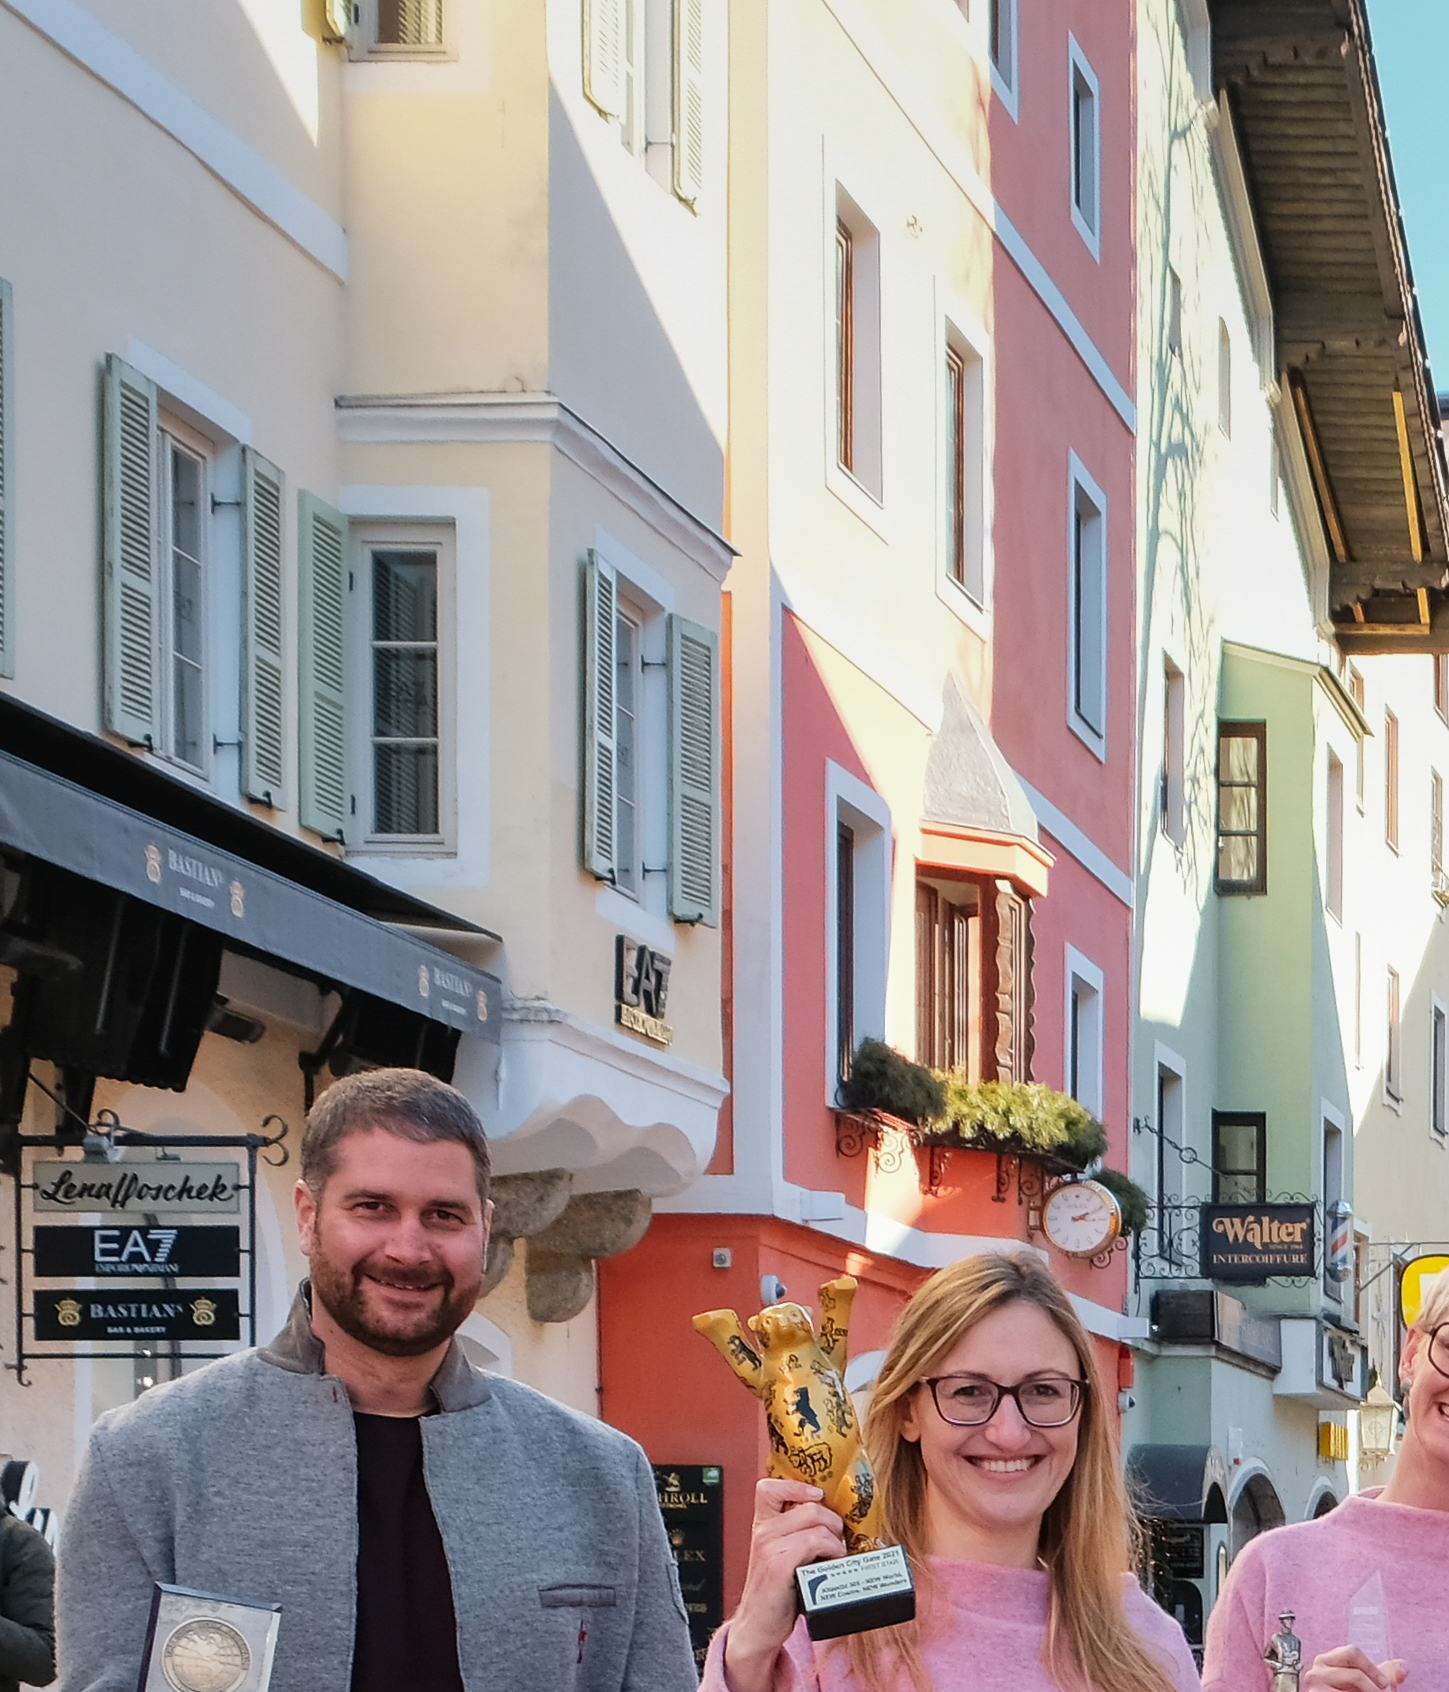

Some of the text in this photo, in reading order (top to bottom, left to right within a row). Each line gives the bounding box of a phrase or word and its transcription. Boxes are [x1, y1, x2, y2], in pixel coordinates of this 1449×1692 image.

[1212, 1215, 1307, 1250] Walter
[94, 1230, 178, 1262] EA7
[1213, 1253, 1308, 1264] INTERCOIFFURE
[658, 1492, 708, 1504] HROLL
[801, 1569, 816, 1577] The
[817, 1563, 845, 1573] Golden
[846, 1558, 861, 1568] City
